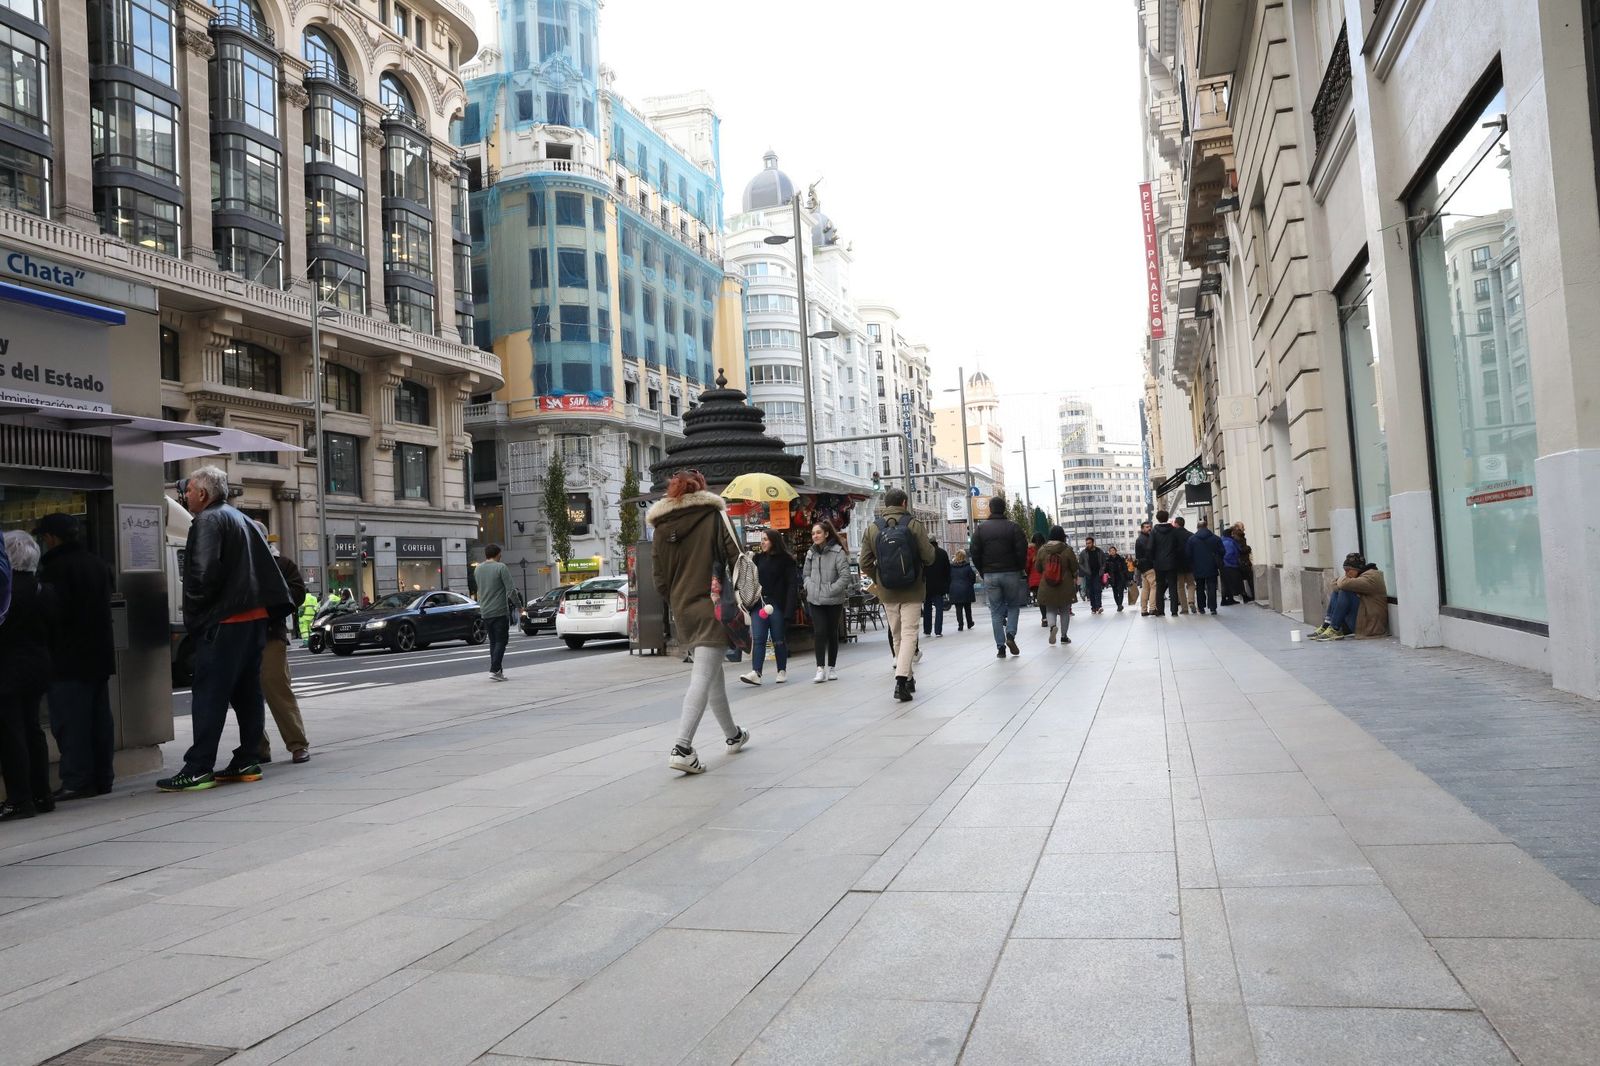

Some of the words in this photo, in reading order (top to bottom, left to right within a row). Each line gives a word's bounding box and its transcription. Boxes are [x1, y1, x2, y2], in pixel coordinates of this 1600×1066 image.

[1142, 191, 1153, 243] PETIT
[1148, 250, 1159, 313] PALACE
[11, 361, 40, 382] del
[44, 368, 104, 393] Estado
[569, 397, 585, 407] SAN
[402, 543, 436, 552] CORTEFIEL
